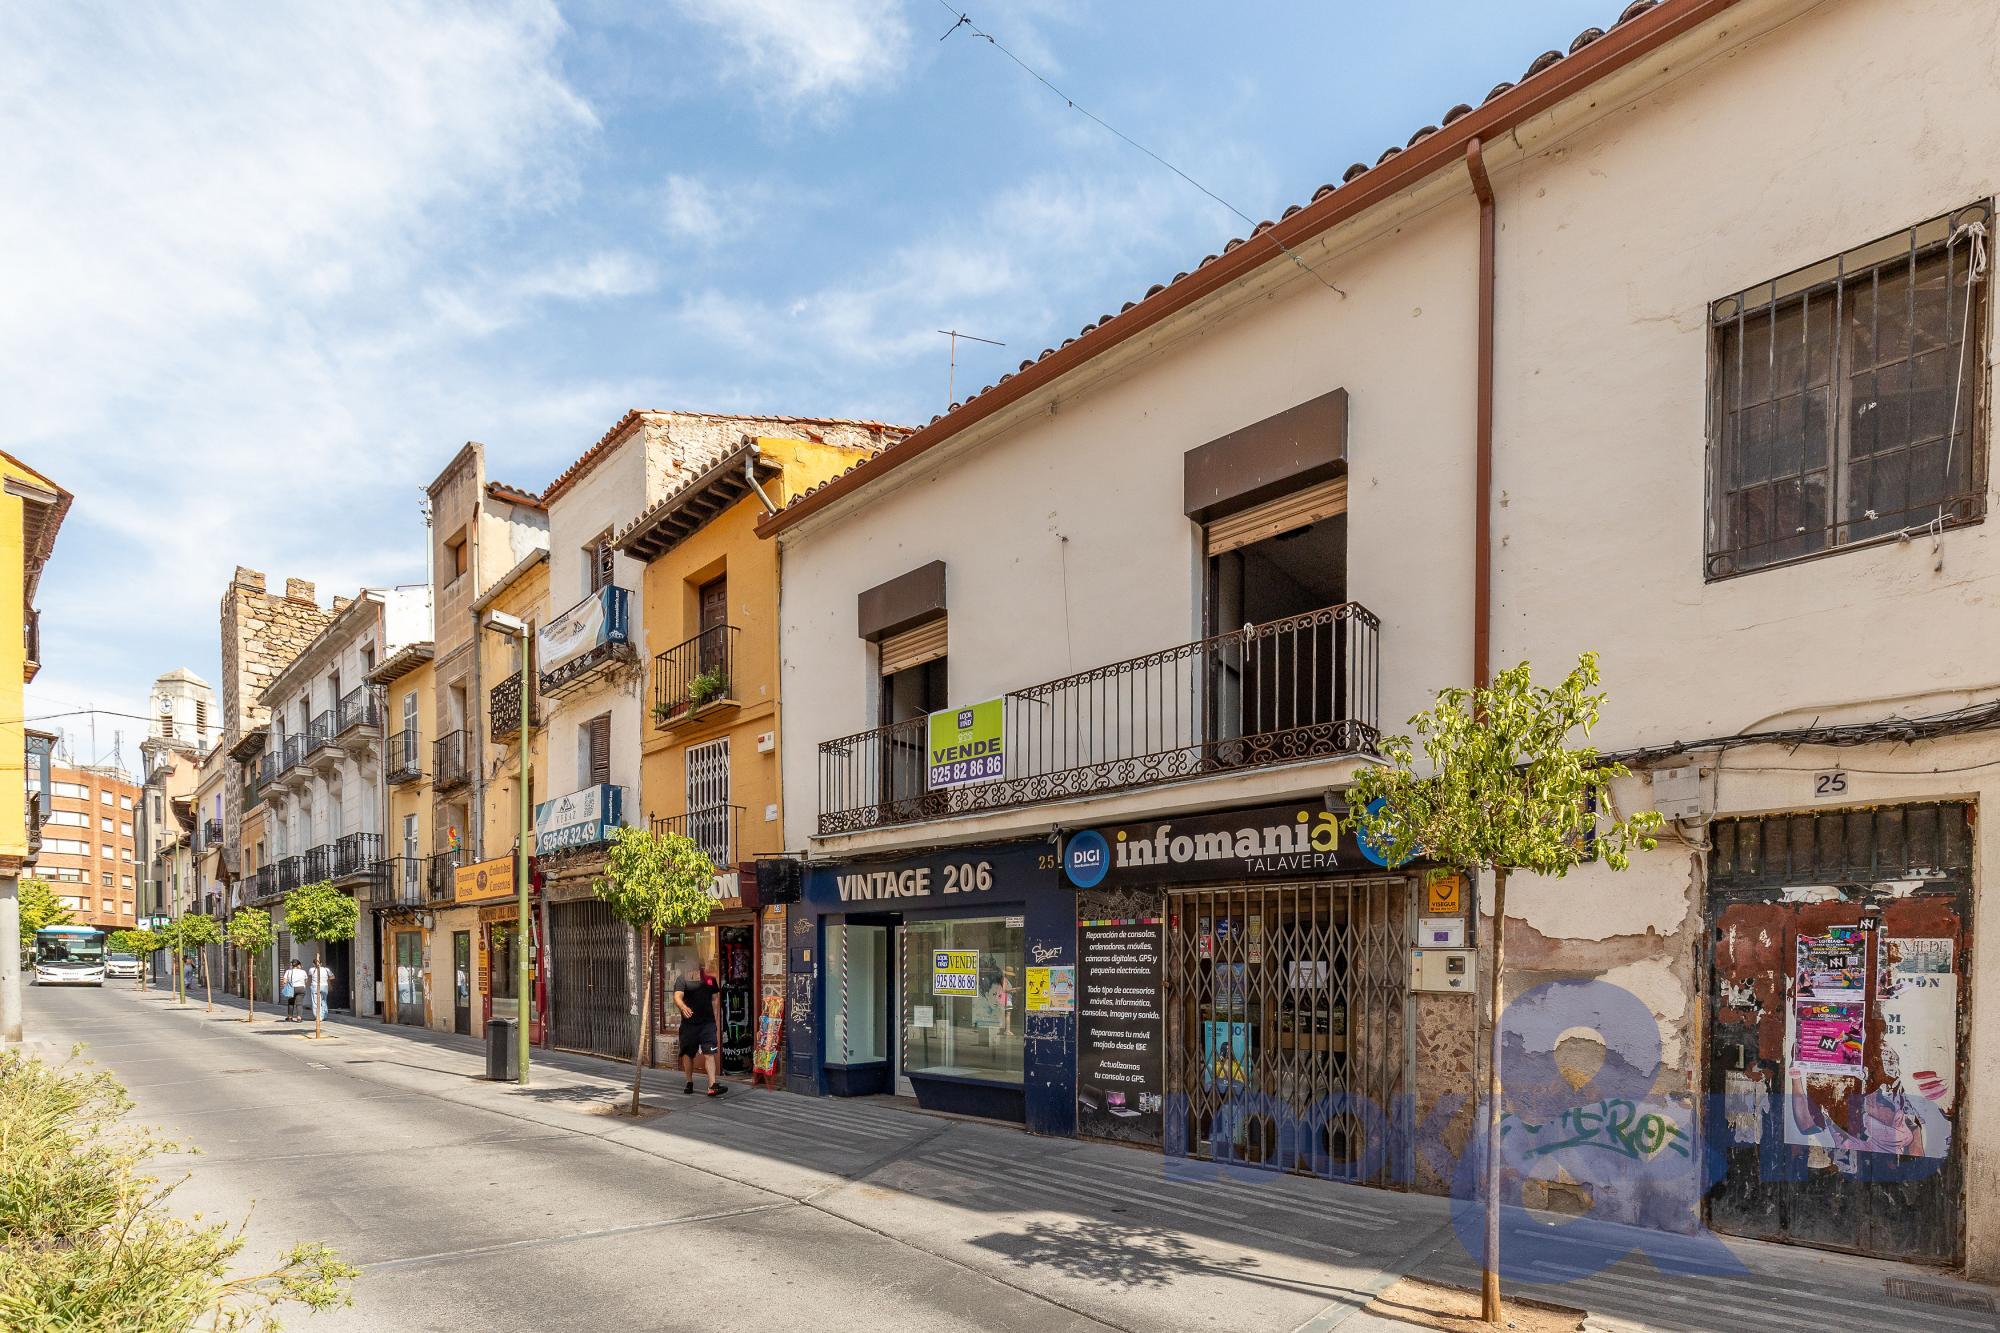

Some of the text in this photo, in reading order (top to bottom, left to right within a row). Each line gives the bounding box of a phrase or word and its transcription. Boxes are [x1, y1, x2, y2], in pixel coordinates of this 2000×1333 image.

[933, 737, 1000, 763] VENDE
[932, 755, 1001, 783] 925 82 86 86
[1817, 773, 1846, 793] 25
[543, 832, 558, 851] 925
[570, 826, 581, 846] 32
[582, 822, 596, 842] 49
[1116, 810, 1338, 868] infomania
[1039, 856, 1054, 870] 25
[1074, 849, 1099, 864] DIGI
[1244, 852, 1338, 872] TALAVERA
[836, 861, 993, 901] VINTAGE 206
[1127, 930, 1156, 938] consolas,
[1127, 942, 1153, 950] móviles,
[950, 955, 976, 968] VENDE
[1111, 955, 1138, 964] digitales,
[1153, 956, 1157, 964] y
[936, 974, 975, 989] 925 82 86 86
[1102, 986, 1113, 995] tipo
[1082, 1009, 1160, 1020] consolas, imagen y sonido.
[1091, 1028, 1124, 1038] Reparamos
[1133, 1030, 1150, 1039] móvil
[1093, 1041, 1115, 1050] mojado
[1116, 1042, 1134, 1050] desde
[1100, 1060, 1140, 1071] Actualizamos
[1102, 1072, 1125, 1081] consola
[1131, 1075, 1146, 1083] GPS.
